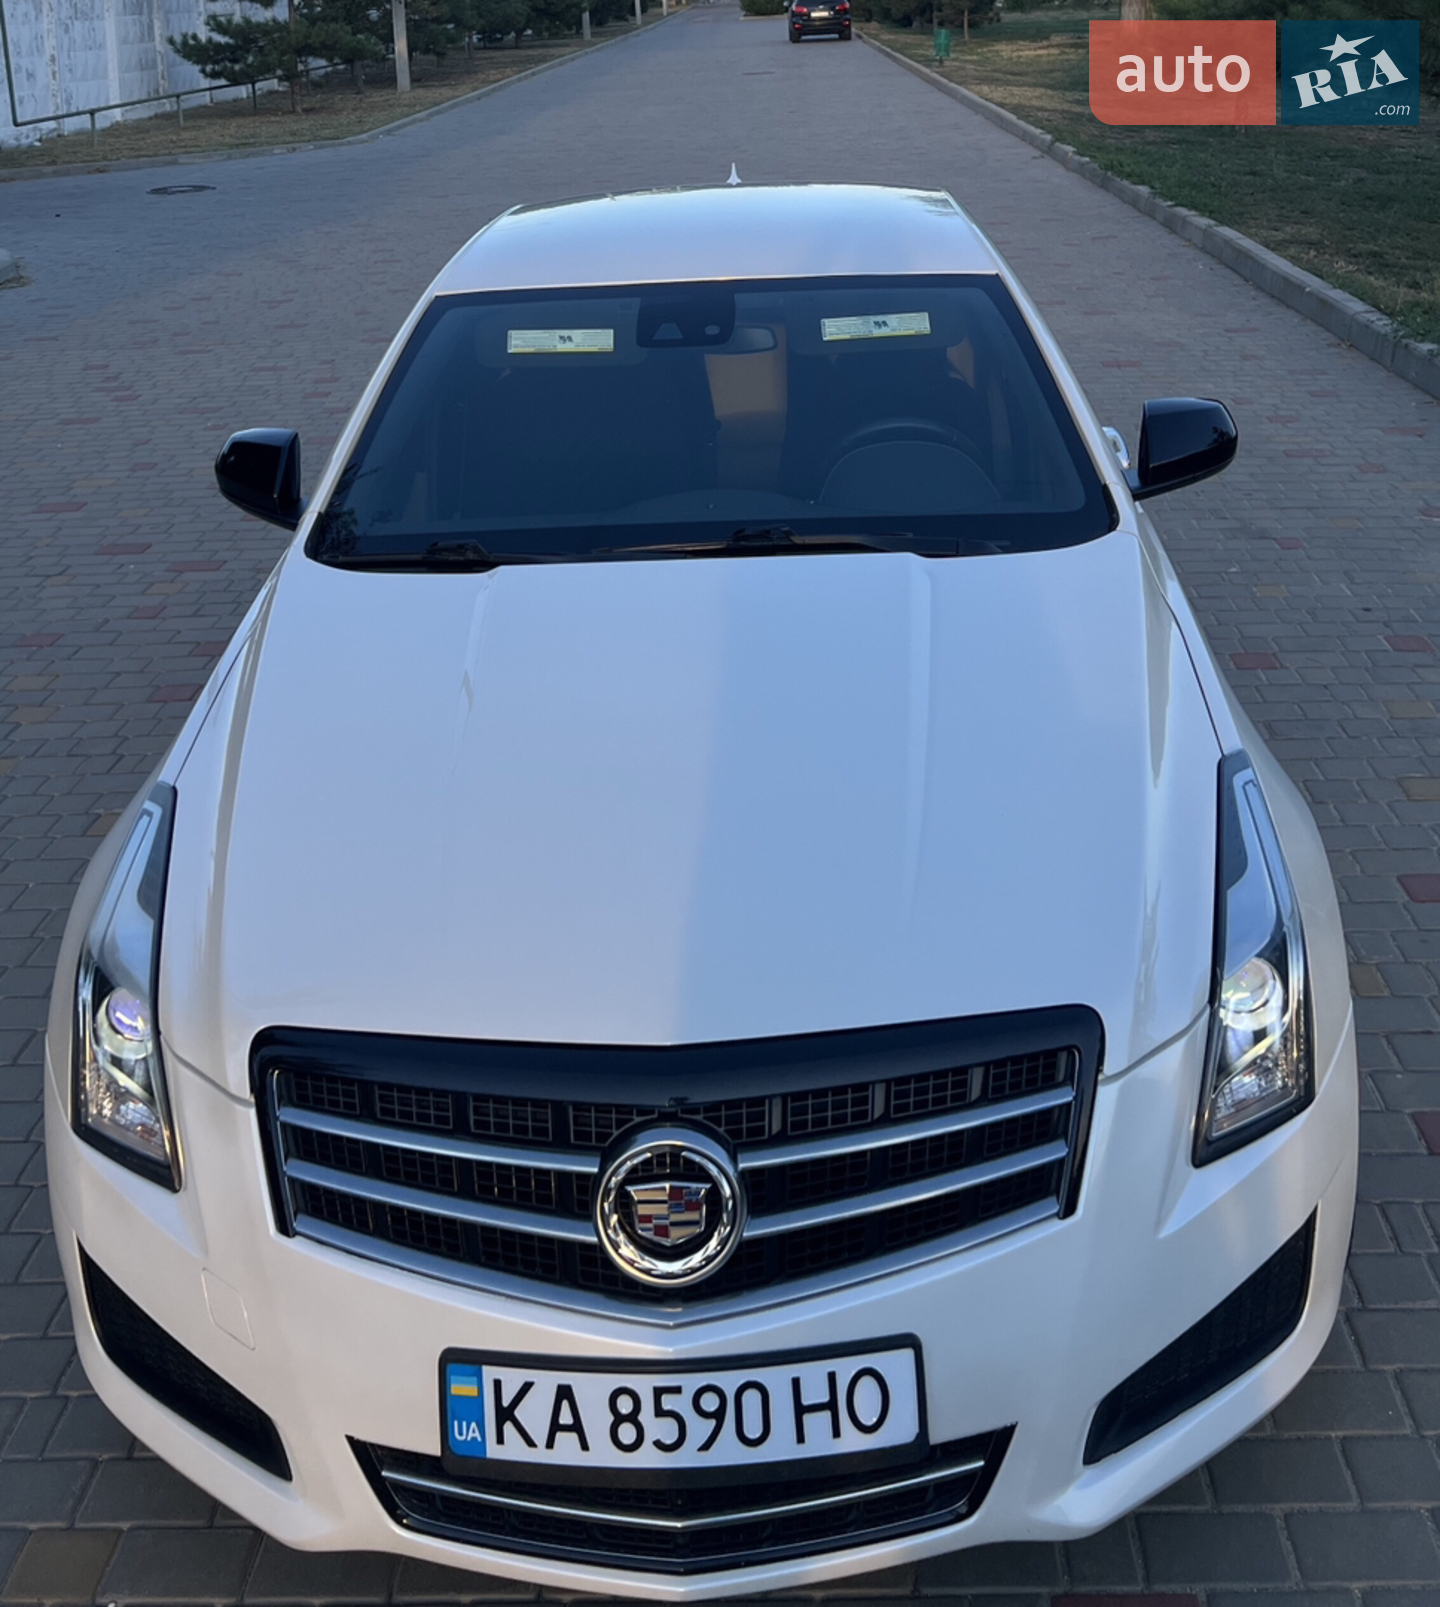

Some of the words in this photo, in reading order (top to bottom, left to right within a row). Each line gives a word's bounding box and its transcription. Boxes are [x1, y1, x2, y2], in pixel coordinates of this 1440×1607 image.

[454, 1420, 482, 1443] UA
[493, 1378, 590, 1452] KA
[608, 1379, 771, 1454] 8590
[791, 1366, 890, 1445] HO
